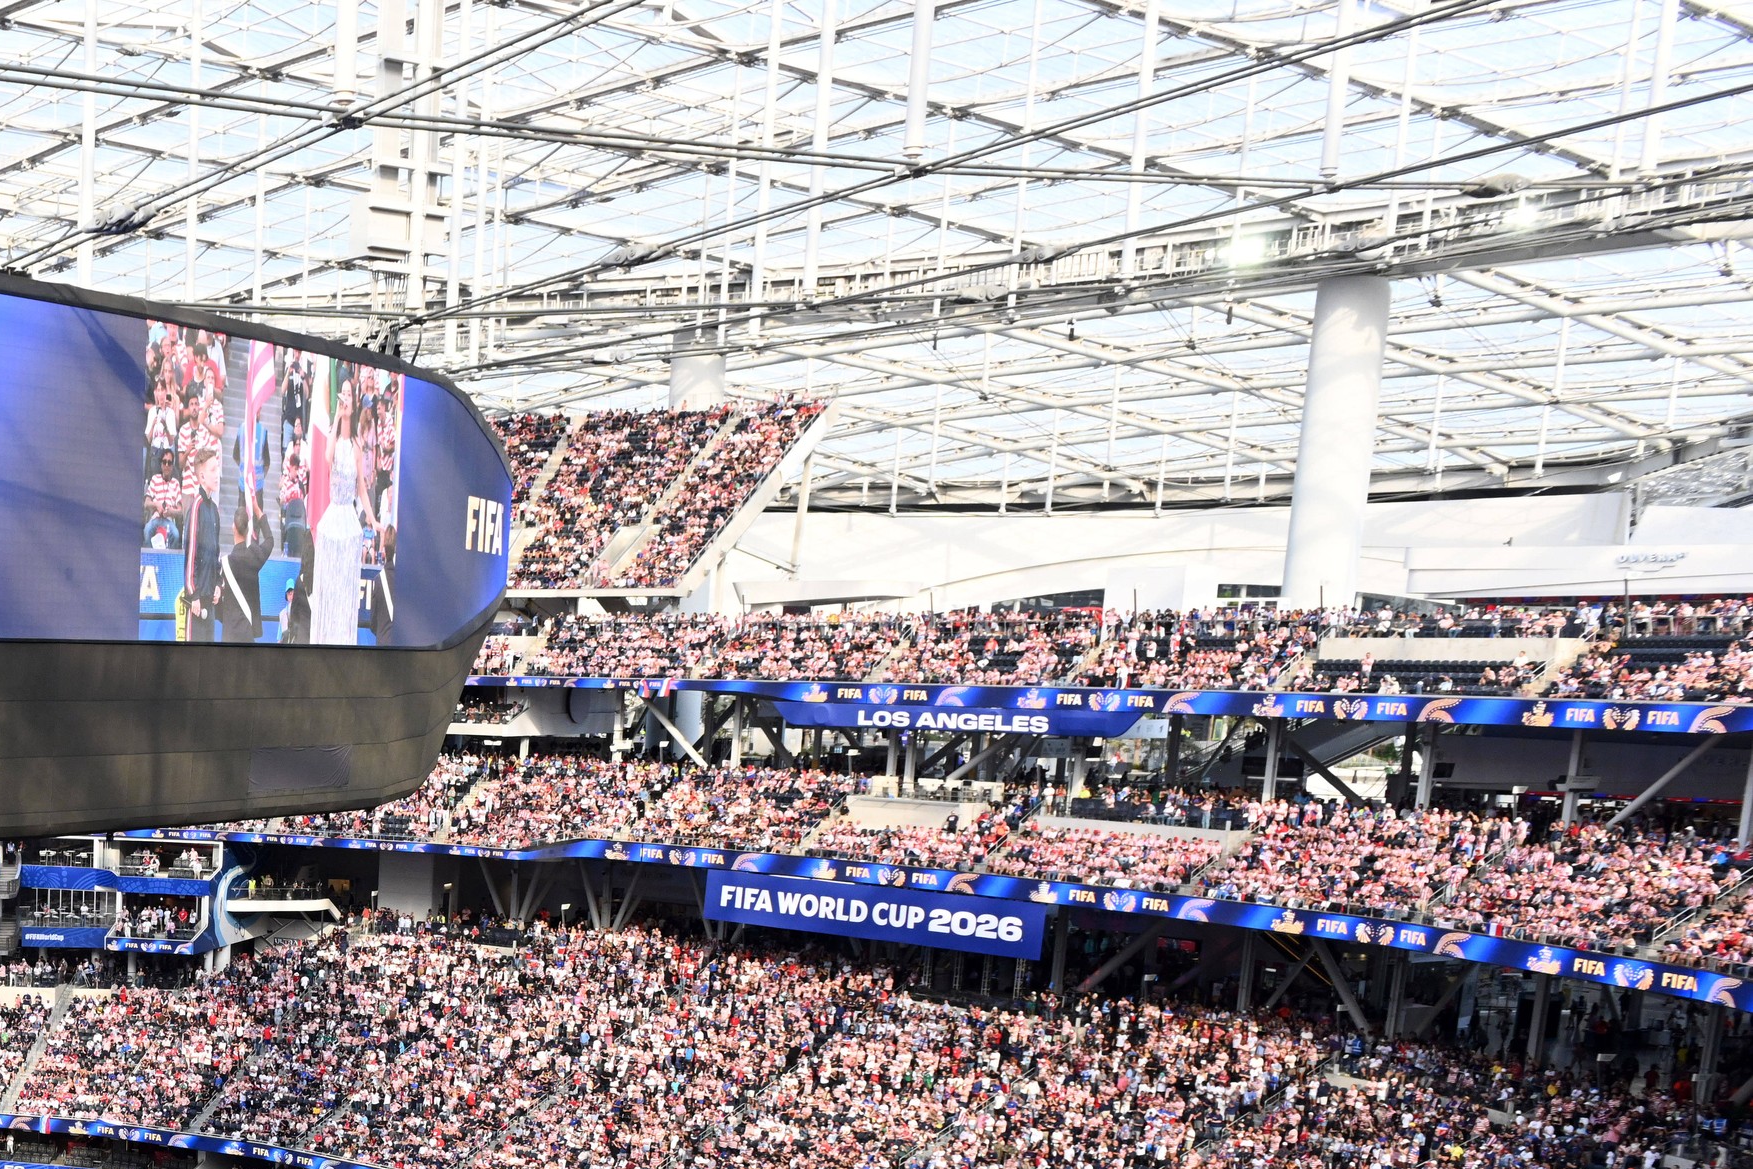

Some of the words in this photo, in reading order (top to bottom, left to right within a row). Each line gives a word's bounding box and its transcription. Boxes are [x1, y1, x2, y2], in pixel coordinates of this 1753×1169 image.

[465, 496, 504, 557] FIFA
[139, 565, 161, 601] A
[358, 578, 373, 610] FI
[837, 687, 863, 699] FIFA
[902, 689, 928, 701] FIFA
[1056, 693, 1083, 706] FIFA
[1126, 694, 1154, 708] FIFA
[1295, 699, 1325, 713] FIFA
[1376, 702, 1408, 716] FIFA
[1565, 707, 1596, 723] FIFA
[857, 709, 910, 727] LOS
[915, 712, 1049, 733] ANGELES
[1646, 710, 1680, 726] FIFA
[464, 847, 476, 855] FIFA
[639, 847, 664, 860] FIFA
[701, 852, 725, 865] FIFA
[845, 866, 871, 879] FIFA
[911, 872, 939, 886] FIFA
[1068, 888, 1096, 904] FIFA
[1141, 897, 1169, 912] FIFA
[720, 885, 773, 913] FIFA
[778, 891, 869, 923] WORLD
[871, 902, 925, 929] CUP
[927, 908, 1023, 942] 2026
[1316, 918, 1348, 935] FIFA
[24, 933, 65, 942] #FIFAWorldCup
[1399, 929, 1426, 946] FIFA
[1573, 957, 1606, 977] FIFA
[1661, 972, 1699, 993] FIFA
[96, 1125, 115, 1135] FIFA
[252, 1146, 270, 1158] FIFA
[296, 1155, 314, 1167] FIFA
